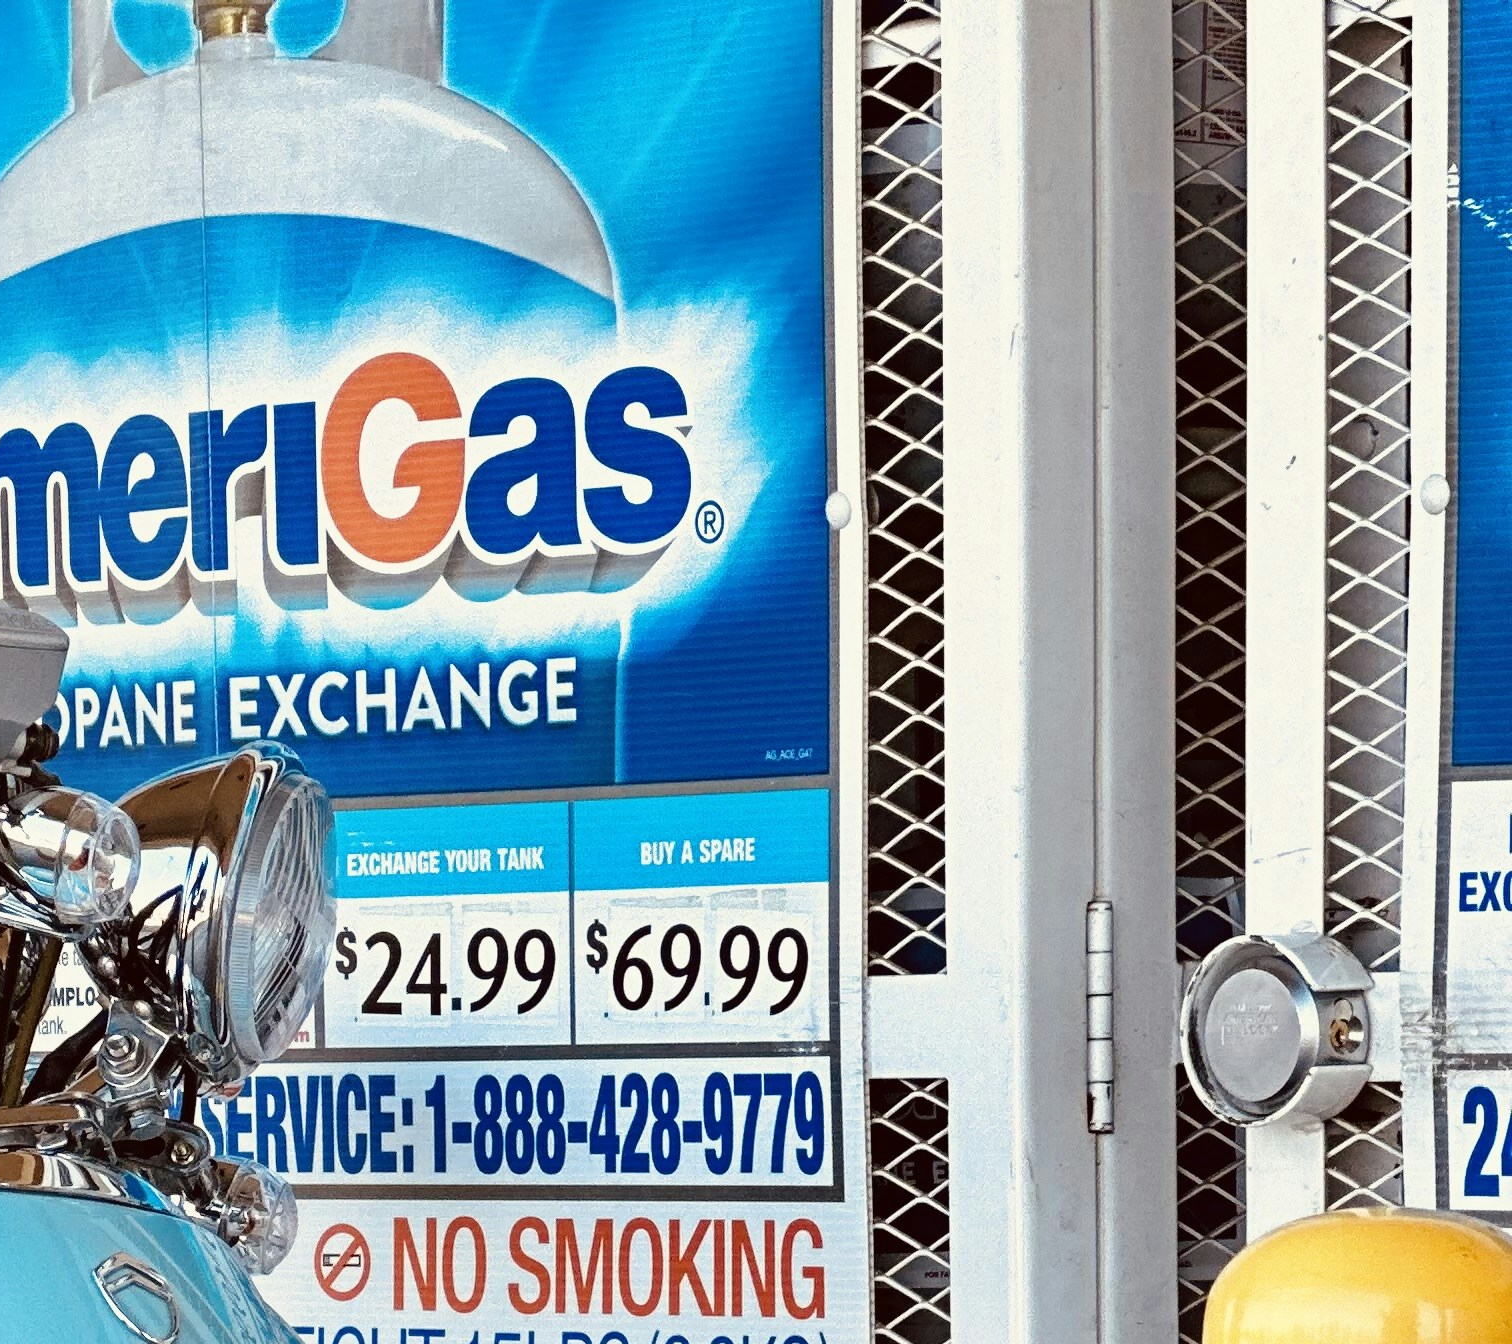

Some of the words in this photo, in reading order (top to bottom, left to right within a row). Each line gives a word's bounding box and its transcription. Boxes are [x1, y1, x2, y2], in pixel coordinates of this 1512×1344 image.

[229, 656, 577, 740] EXCHANGE
[346, 850, 440, 877] EXCHANGE
[444, 849, 492, 873] YOUR
[498, 846, 545, 871] TANK
[640, 841, 677, 866] BUY
[681, 840, 694, 864] A
[699, 837, 756, 863] SPARE
[336, 927, 556, 1016] $24.99
[587, 919, 809, 1017] $69.99
[200, 1072, 415, 1176] SERVICE:
[425, 1071, 825, 1175] 1-888-428-9779
[393, 1216, 487, 1313] NO
[507, 1217, 826, 1319] SMOKING
